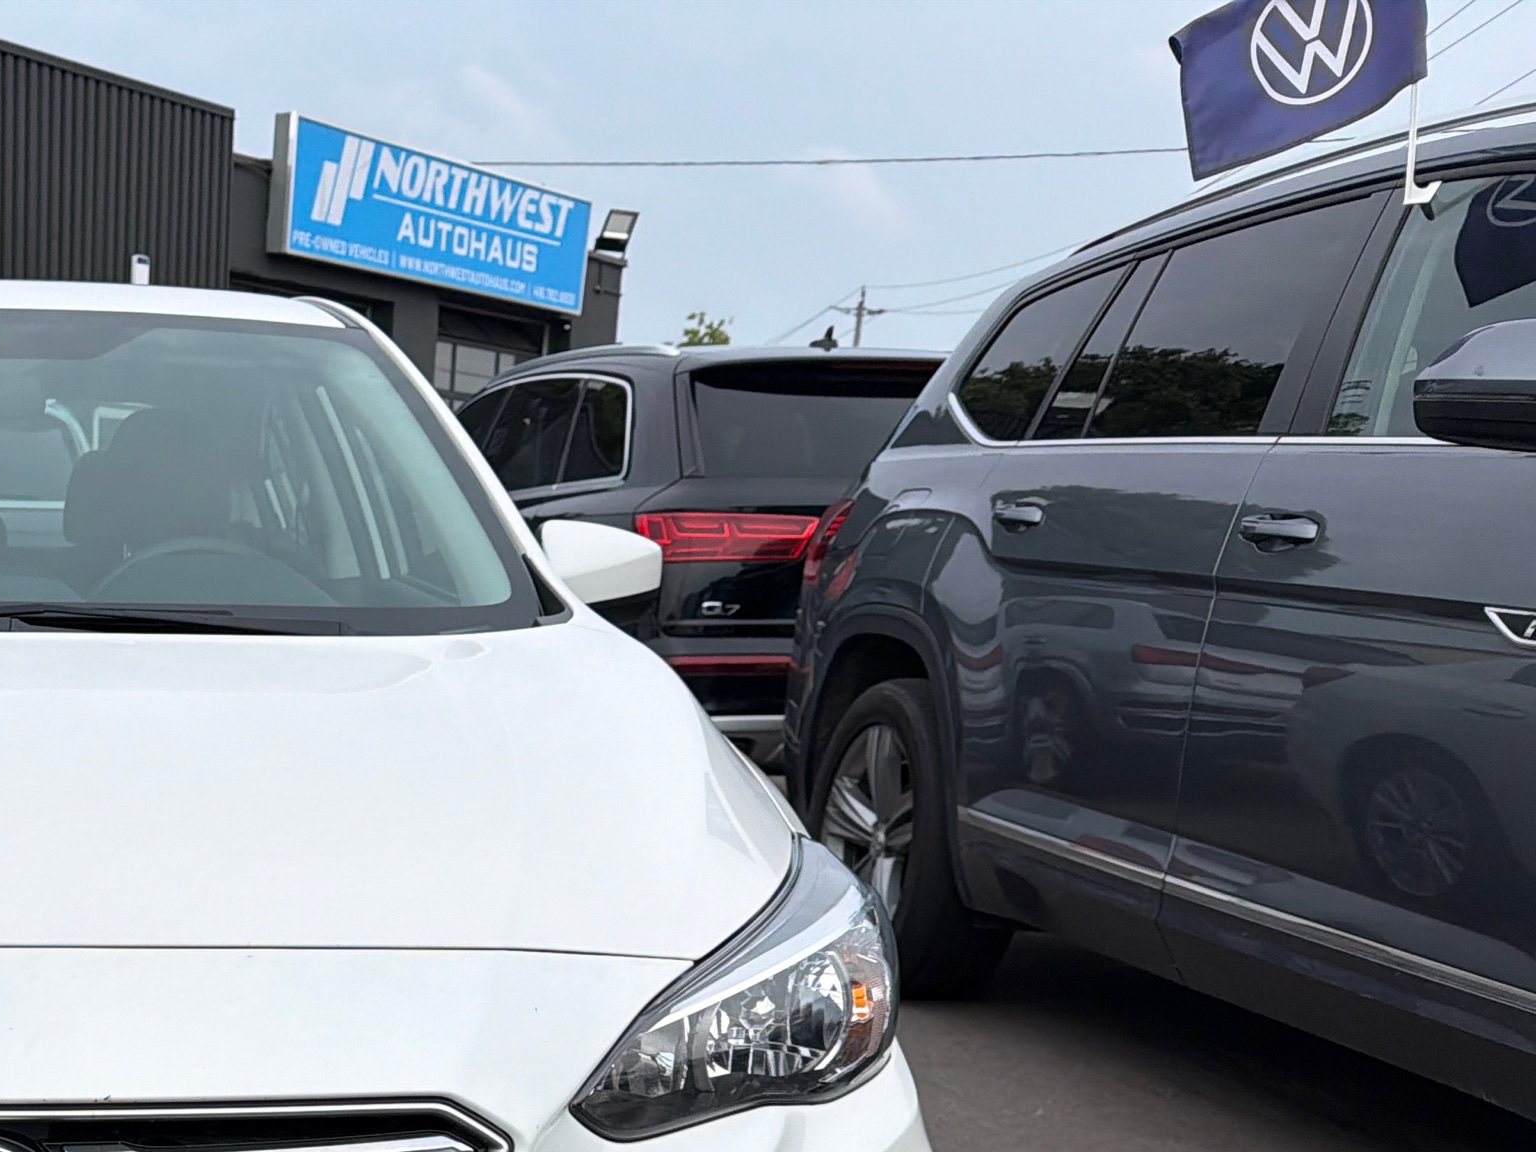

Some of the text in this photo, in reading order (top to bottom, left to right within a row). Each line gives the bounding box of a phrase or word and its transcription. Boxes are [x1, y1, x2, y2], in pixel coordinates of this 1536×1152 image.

[373, 146, 574, 239] NORTHWEST
[397, 213, 538, 273] AUTOHAUS
[701, 600, 741, 616] Q7
